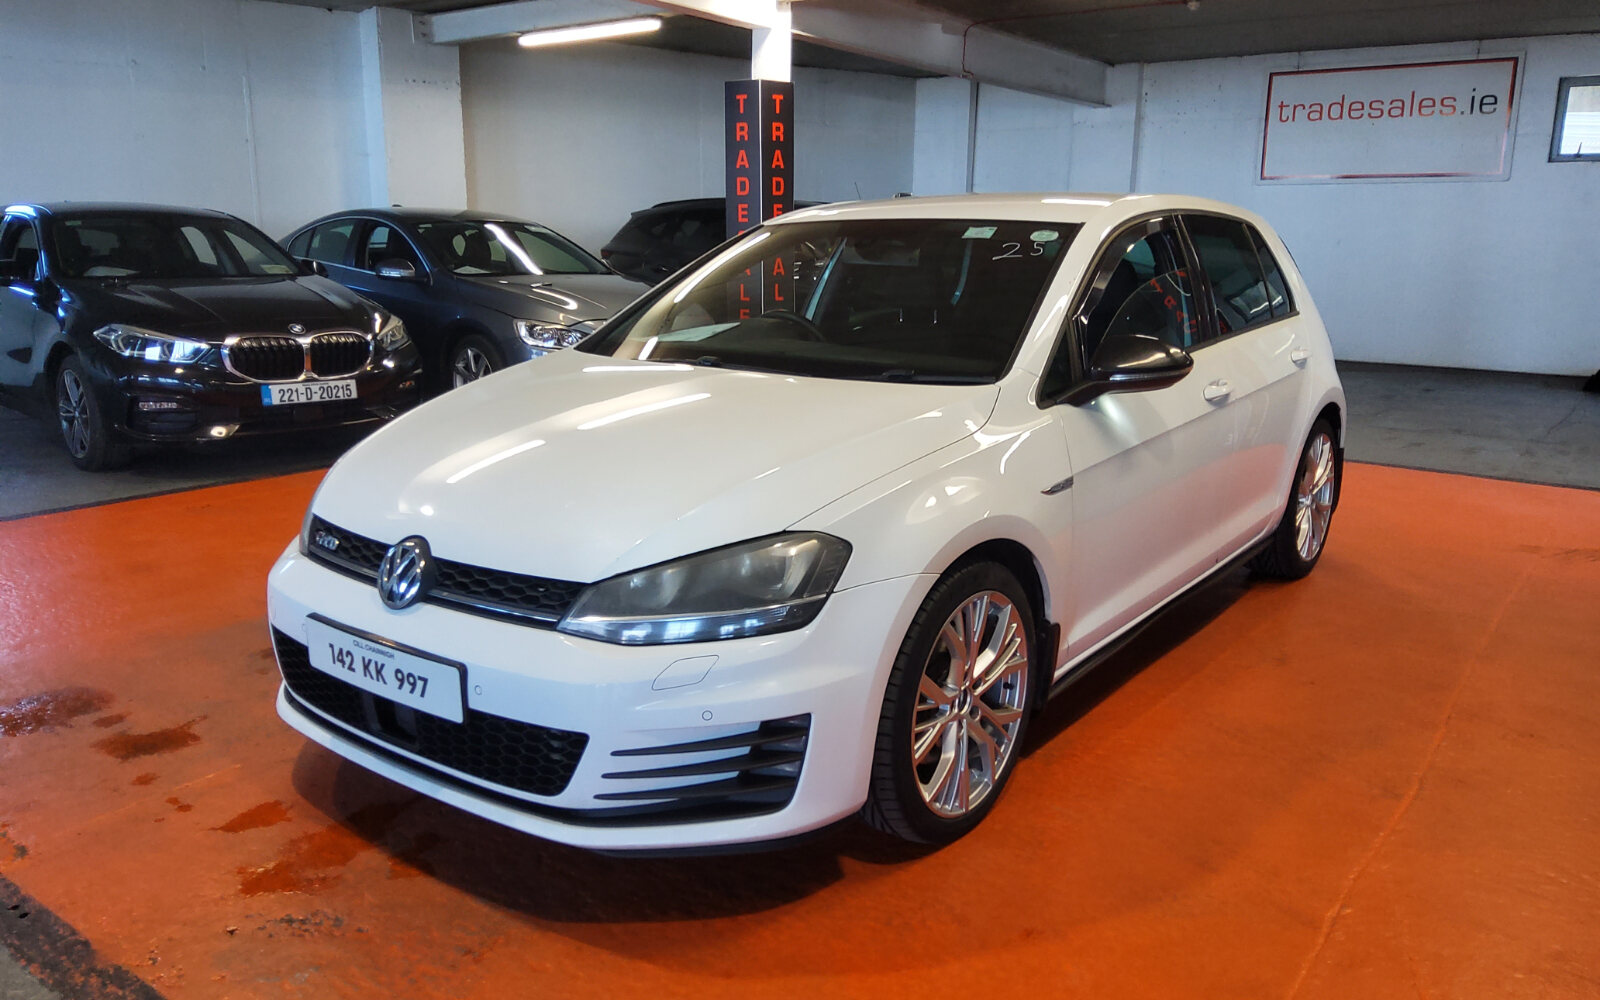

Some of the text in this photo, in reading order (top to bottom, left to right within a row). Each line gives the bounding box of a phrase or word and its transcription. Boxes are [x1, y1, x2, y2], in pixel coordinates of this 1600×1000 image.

[1277, 87, 1499, 123] tradesales.ie
[278, 383, 353, 403] 221-D-20215
[328, 642, 429, 699] 142 KK 997
